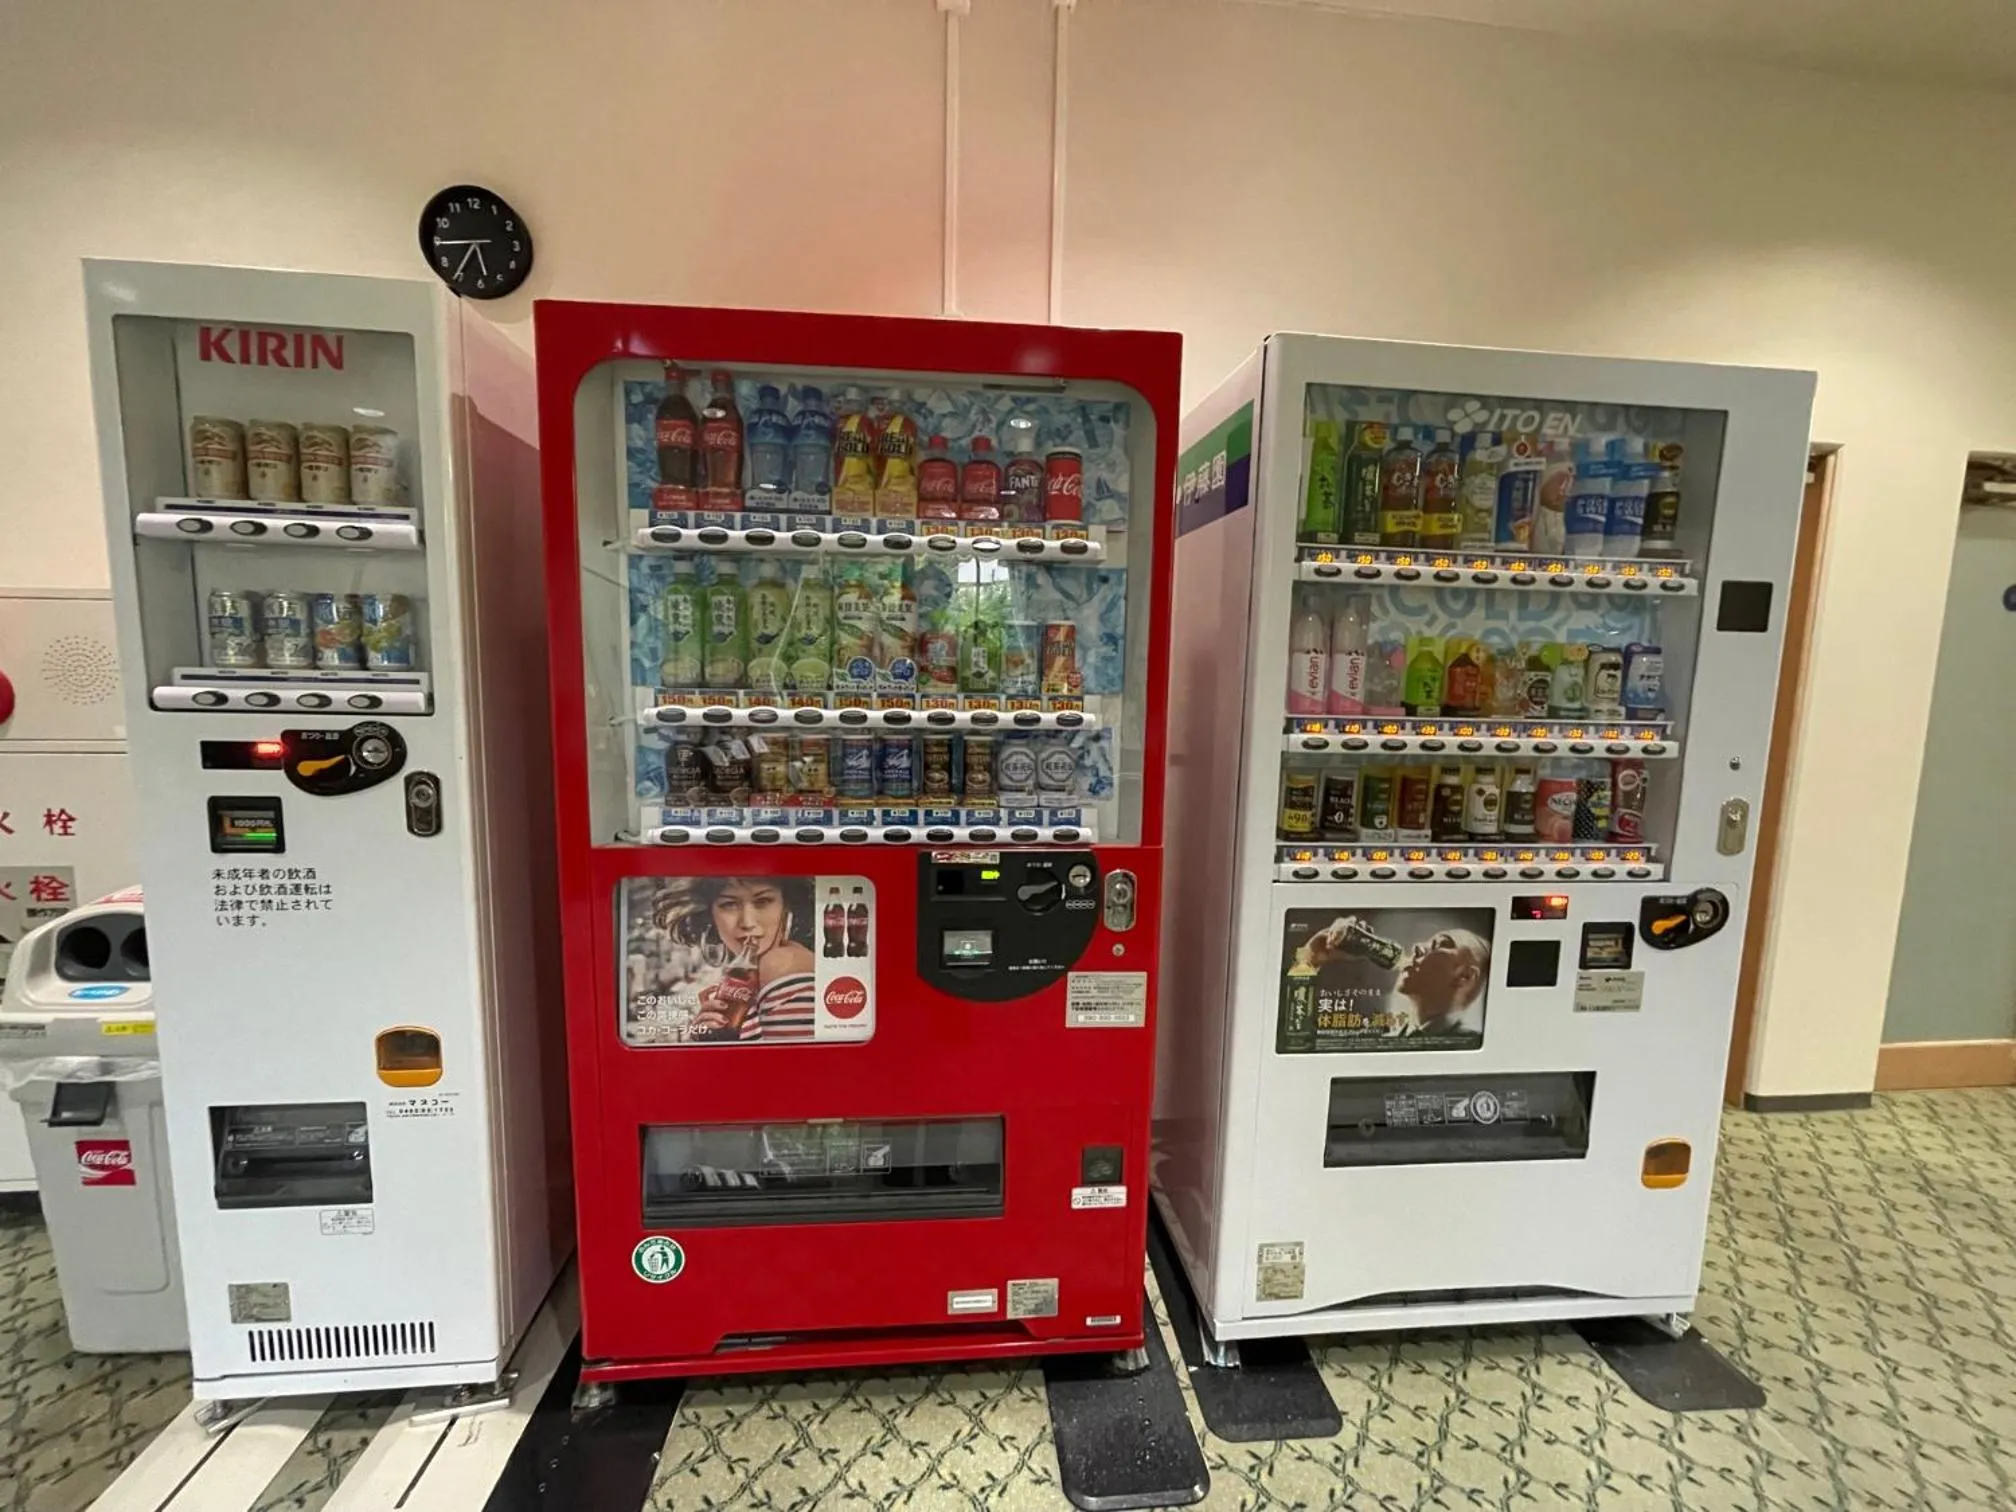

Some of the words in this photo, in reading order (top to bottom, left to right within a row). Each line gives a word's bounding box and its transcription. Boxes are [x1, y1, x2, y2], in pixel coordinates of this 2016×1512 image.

[448, 202, 460, 213] 11
[467, 198, 480, 209] 12
[491, 204, 497, 215] 1
[436, 217, 450, 228] 10
[505, 220, 513, 231] 2
[513, 241, 520, 251] 3
[441, 256, 448, 267] 8
[477, 279, 485, 288] 6
[199, 326, 344, 370] KIRIN
[1486, 408, 1541, 433] ITO
[1542, 412, 1583, 436] EN
[1307, 656, 1321, 689] evian
[1347, 657, 1361, 690] evian
[212, 867, 317, 880] 未成年者の飲酒
[214, 883, 333, 896] および飲酒運転は
[215, 899, 334, 912] 法律で禁止されて
[216, 915, 267, 927] います。
[1318, 999, 1355, 1013] 実は!
